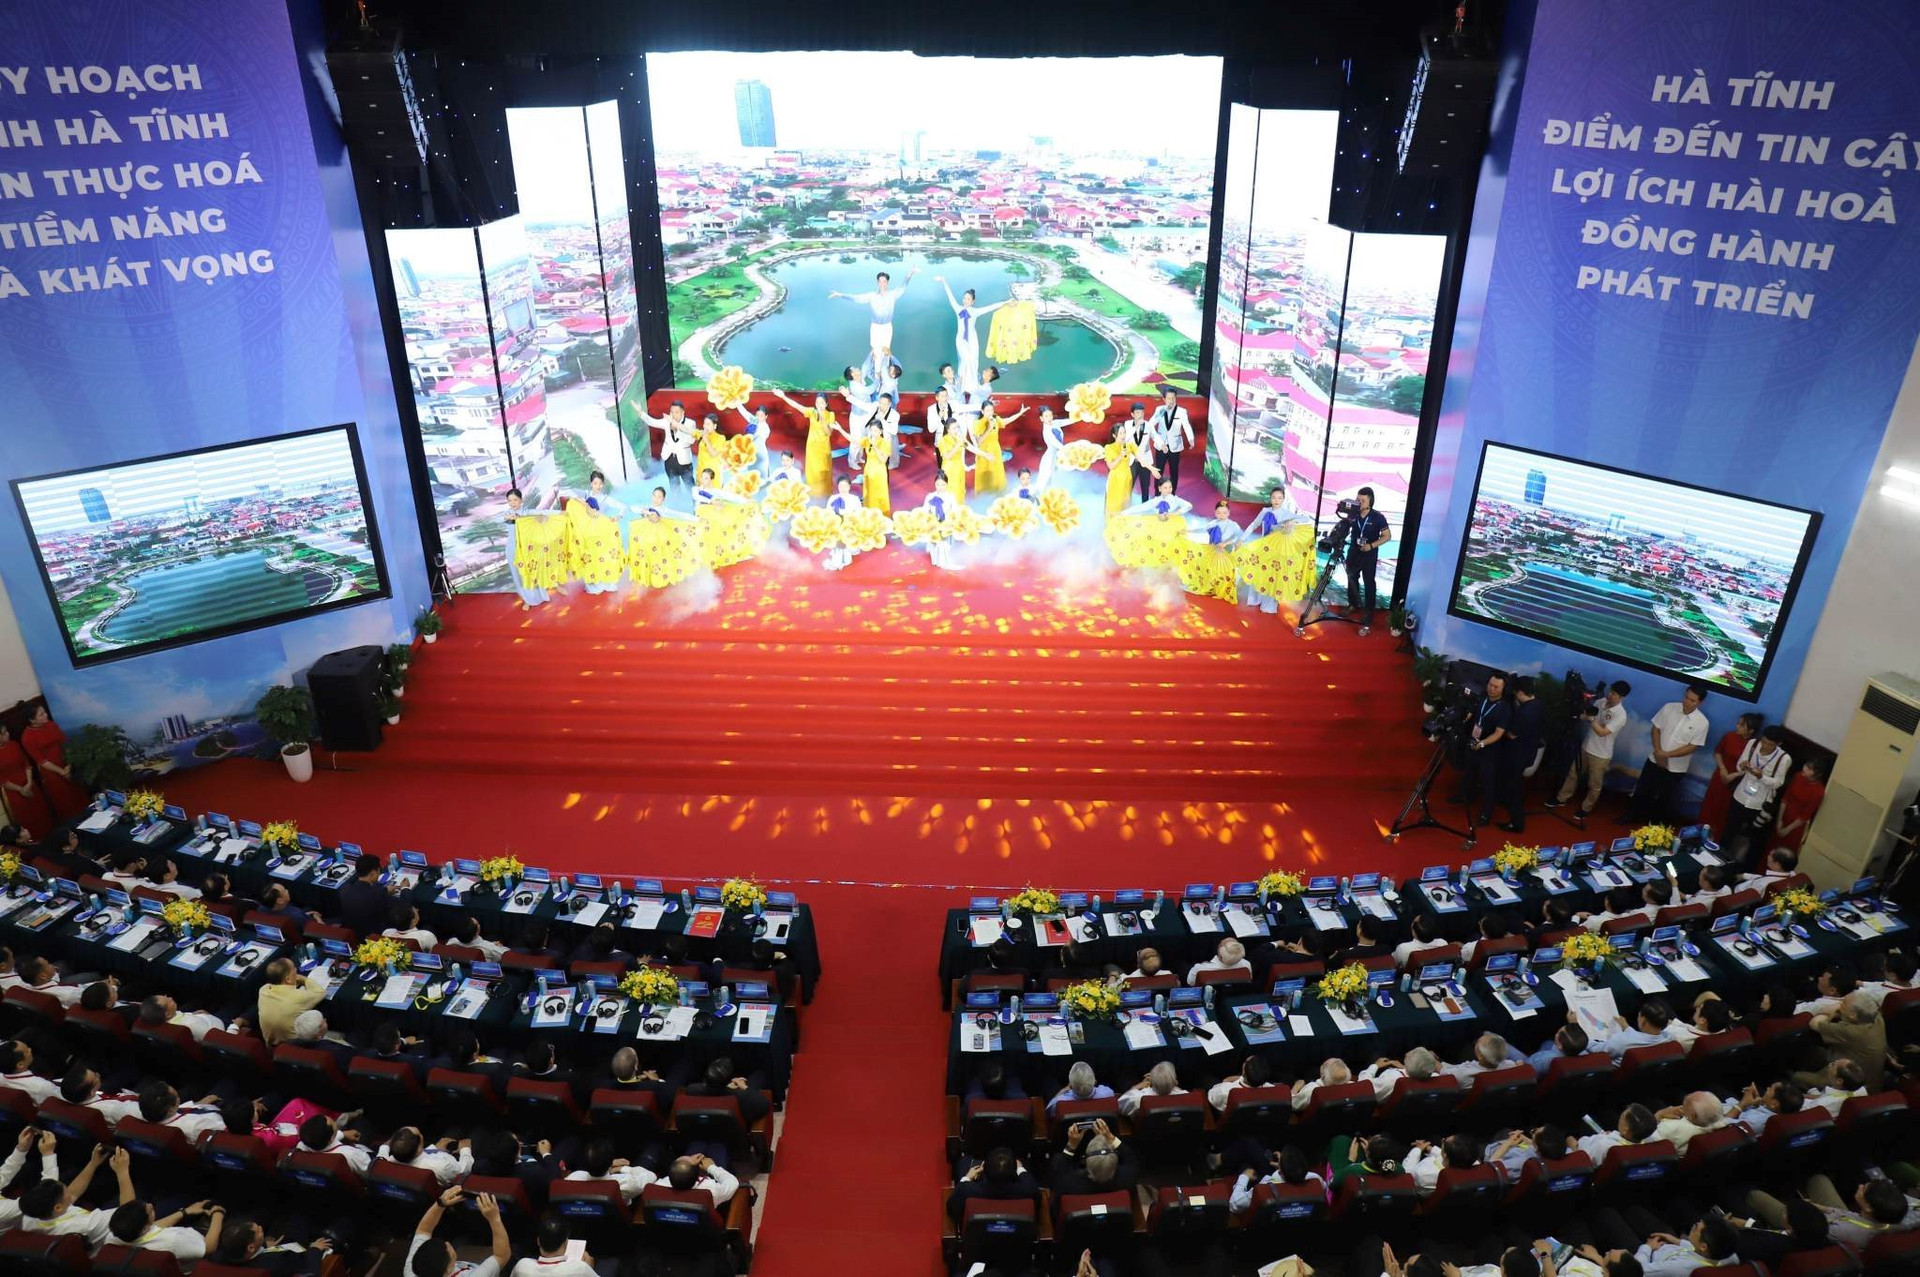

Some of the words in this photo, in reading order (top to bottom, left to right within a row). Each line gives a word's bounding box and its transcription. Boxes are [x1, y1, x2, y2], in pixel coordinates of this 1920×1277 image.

[45, 64, 202, 100] HOẠCH
[1652, 69, 1710, 105] HÀ
[1728, 71, 1835, 111] TĨNH
[54, 110, 122, 146] HÀ
[129, 107, 229, 142] TĨNH
[1543, 112, 1642, 152] ĐIỂM
[1654, 119, 1742, 159] ĐẾN
[1757, 133, 1830, 165] TIN
[1844, 132, 1920, 178] CẬ
[43, 161, 163, 200] THỰC
[174, 152, 263, 189] HOÁ
[1552, 167, 1614, 203] LỢI
[1625, 169, 1695, 206] ÍCH
[1706, 178, 1784, 215] HÀI
[1796, 187, 1896, 225] HOÀ
[0, 211, 99, 250] TIỀM
[110, 206, 226, 241] NĂNG
[1581, 213, 1697, 256] ĐỒNG
[1708, 230, 1835, 271] HÀNH
[38, 257, 150, 295] KHÁT
[161, 249, 274, 286] VỌNG
[1577, 266, 1680, 301] PHÁT
[1692, 280, 1814, 319] TRIỂN
